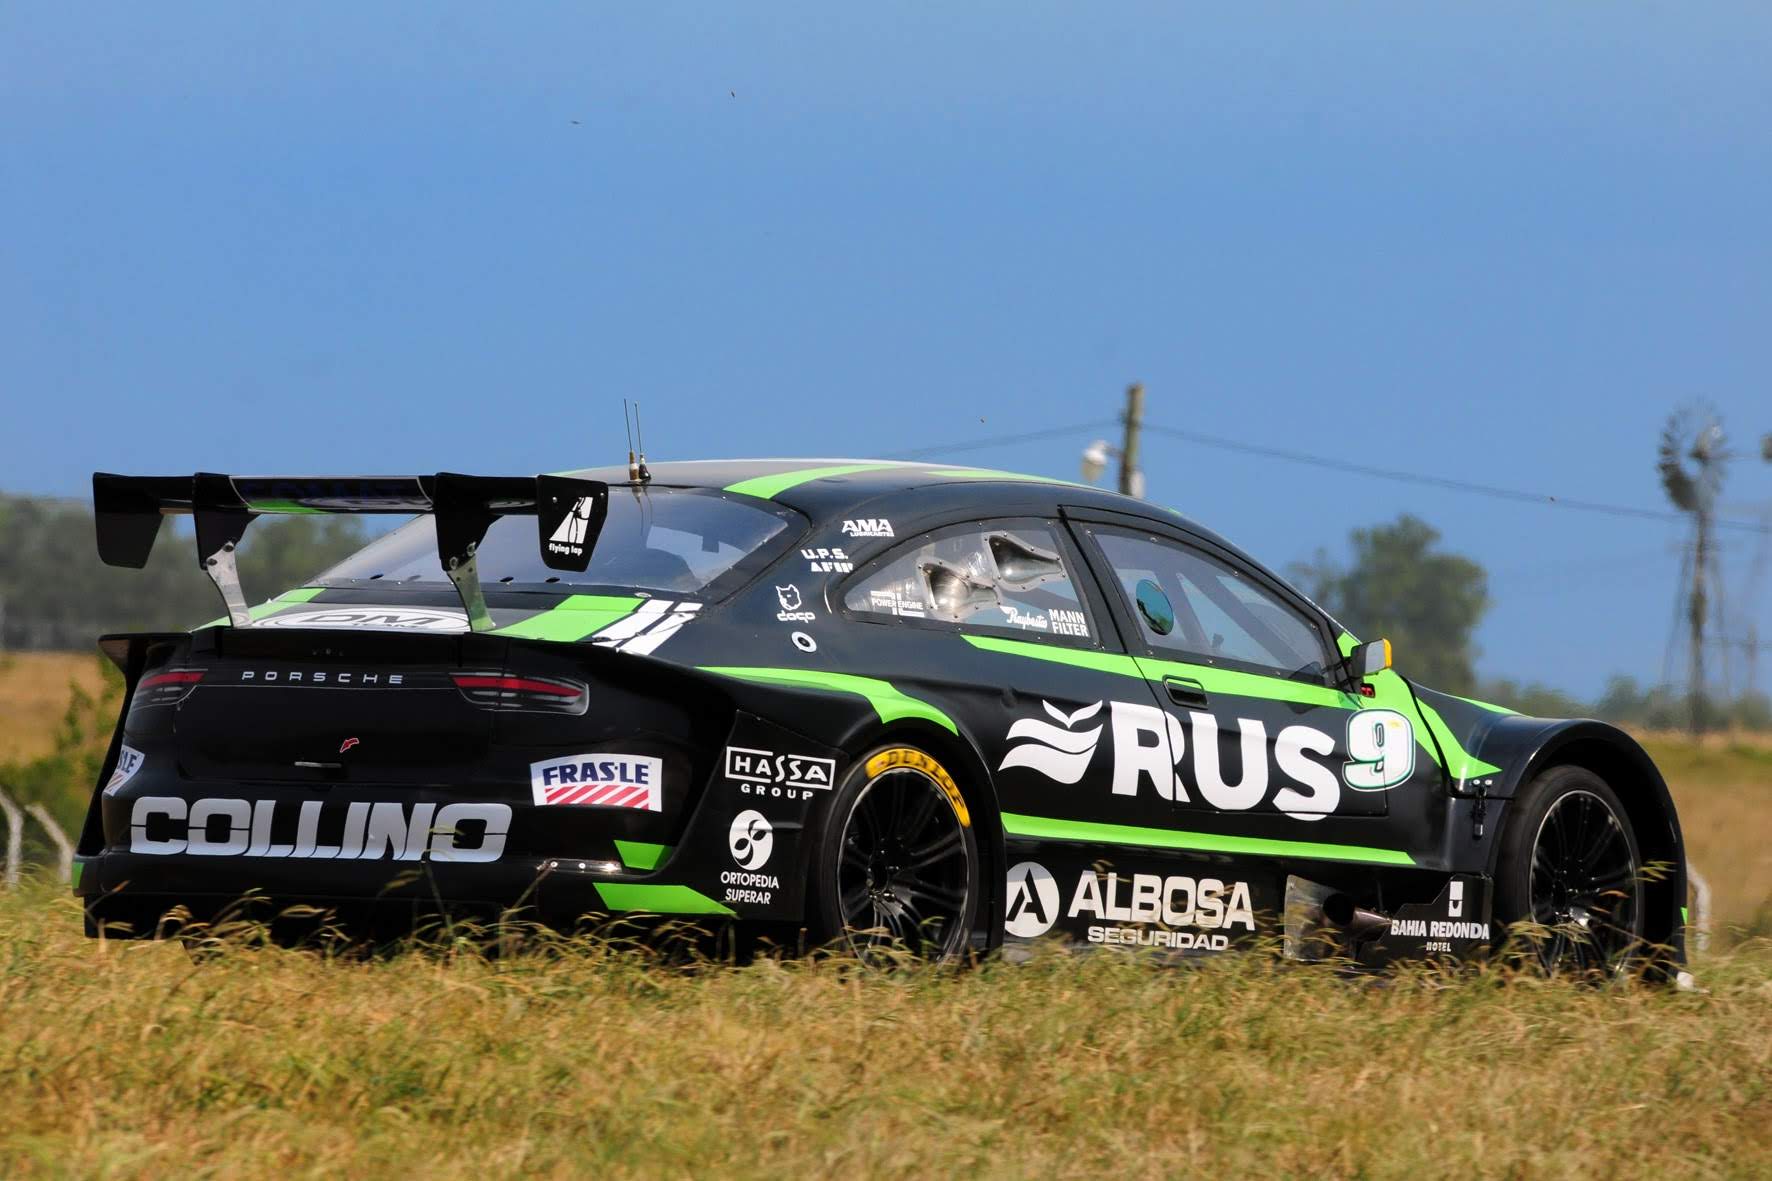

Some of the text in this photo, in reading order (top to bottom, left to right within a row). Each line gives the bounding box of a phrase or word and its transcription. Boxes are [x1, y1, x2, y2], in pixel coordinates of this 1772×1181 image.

[842, 519, 893, 533] AMA
[549, 543, 583, 556] flying lap
[872, 598, 896, 608] POWER
[1049, 609, 1086, 625] MANN
[1052, 621, 1089, 637] FILTER
[242, 671, 403, 684] PORSCHE
[1342, 708, 1416, 792] 9
[735, 755, 828, 783] HASSA
[1110, 701, 1341, 821] RUS
[741, 783, 814, 800] GROUP
[130, 796, 513, 863] COLLINO
[720, 871, 779, 889] ORTOPEDIA
[725, 888, 771, 904] SUPERAR
[1067, 870, 1255, 931] ALBOSA
[1087, 926, 1229, 950] SEGURIDAD
[1391, 919, 1490, 940] BAHIA REDONDA
[1425, 941, 1451, 952] HOTEL
